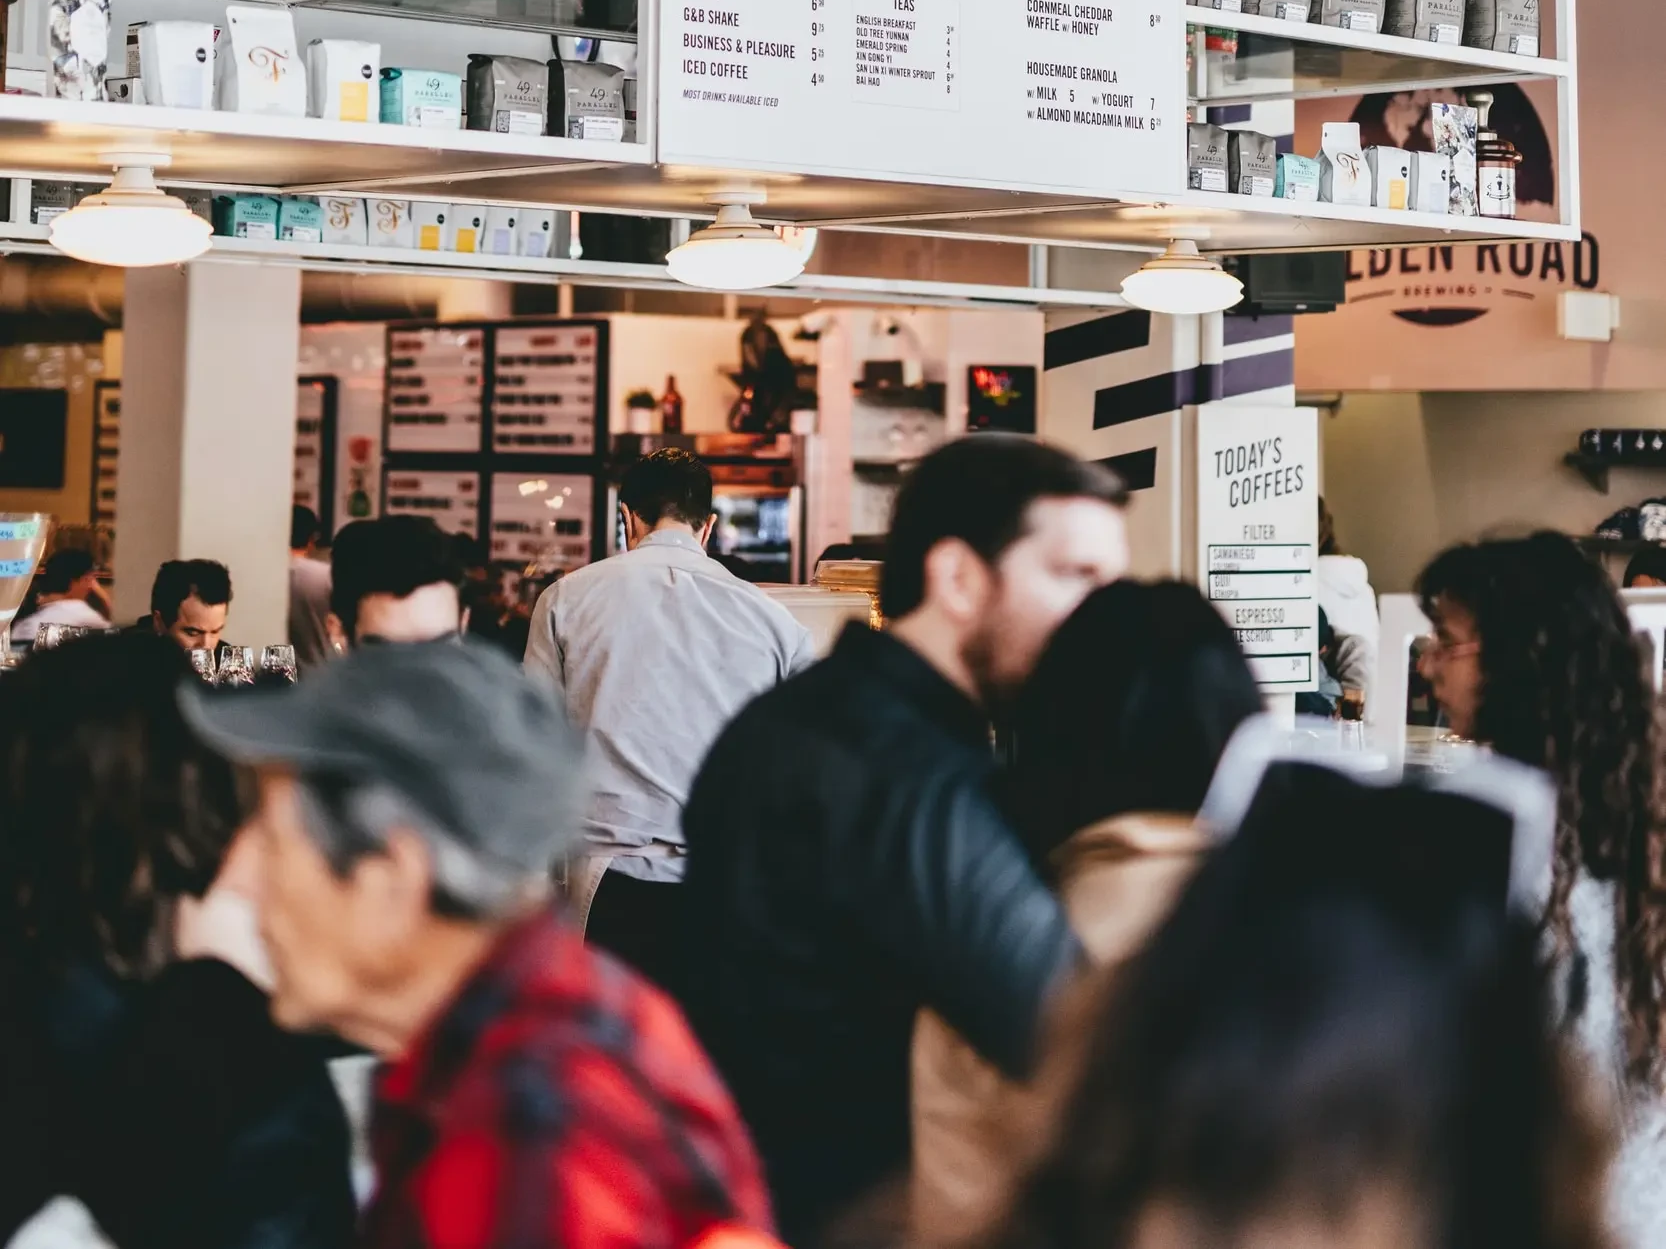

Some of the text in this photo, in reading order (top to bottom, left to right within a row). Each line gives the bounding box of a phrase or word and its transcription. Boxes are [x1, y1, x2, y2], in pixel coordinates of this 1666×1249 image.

[683, 7, 704, 23] G&B
[708, 10, 740, 27] SHAKE
[812, 23, 817, 36] 9
[856, 14, 882, 26] ENGLISH
[883, 18, 916, 31] BREAKFAST
[1027, 15, 1060, 32] WAFFLE
[1072, 21, 1099, 36] HONEY
[1074, 5, 1112, 21] CHEDDAR
[1150, 14, 1155, 27] 8
[856, 27, 867, 37] OLD
[870, 28, 884, 38] TREE
[886, 30, 909, 41] YUNNAN
[683, 33, 732, 52] BUSINESS
[736, 39, 742, 53] &
[747, 41, 796, 59] PLEASURE
[812, 48, 817, 61] 5
[856, 39, 883, 51] EMERALD
[885, 42, 907, 53] SPRING
[856, 51, 866, 61] XIN
[868, 53, 884, 63] GONG
[886, 55, 892, 64] YI
[683, 59, 706, 74] ICED
[710, 63, 748, 79] COFFEE
[811, 73, 817, 86] 4
[856, 63, 868, 73] SAN
[870, 65, 879, 74] LIN
[881, 66, 887, 75] XI
[888, 67, 911, 78] WINTER
[913, 69, 935, 80] SPROUT
[1027, 61, 1118, 84] HOUSEMADE GRANOLA
[856, 76, 866, 85] BAI
[868, 76, 880, 87] HAO
[683, 89, 779, 107] MOST DRINKS AVAILABLE ICED
[1037, 86, 1057, 101] MILK
[1069, 90, 1075, 102] 5
[1102, 93, 1134, 108] YOGURT
[1150, 98, 1155, 110] 7
[1037, 107, 1071, 123] ALMOND
[1074, 110, 1122, 128] MACADAMIA
[1125, 116, 1144, 130] MILK
[1150, 118, 1155, 130] 6
[1215, 437, 1282, 478] TODAY'S
[1230, 464, 1303, 508] COFFEES
[1243, 524, 1275, 540] FILTER
[1236, 608, 1285, 624] ESPRESSO
[1246, 630, 1274, 643] SCHOOL
